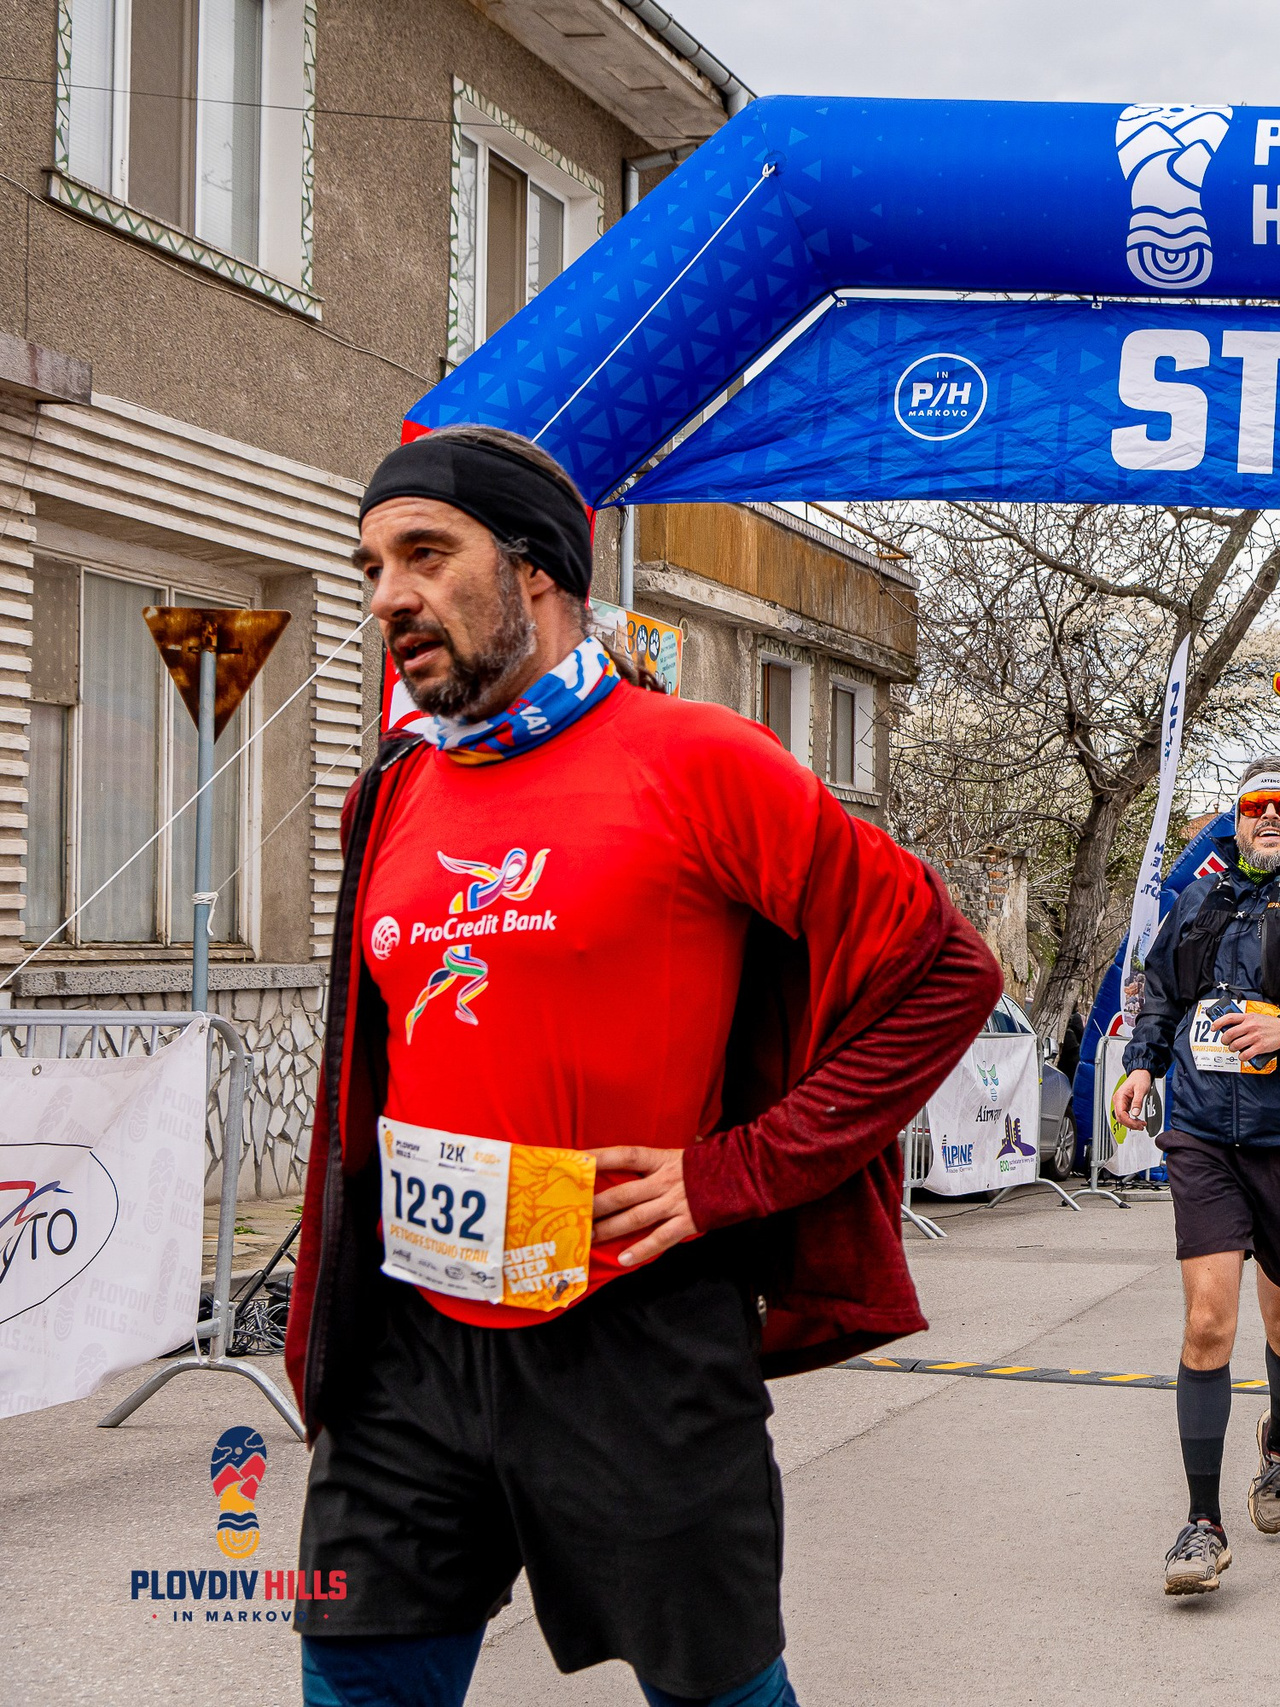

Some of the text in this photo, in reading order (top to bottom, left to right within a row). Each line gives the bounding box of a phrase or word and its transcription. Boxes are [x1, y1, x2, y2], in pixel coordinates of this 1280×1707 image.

[936, 371, 949, 379] IN
[911, 382, 972, 408] P/H
[908, 409, 968, 417] MARKOVO
[410, 910, 558, 944] ProCredit Bank
[440, 1142, 465, 1163] 12K
[390, 1169, 486, 1242] 1232
[503, 1259, 548, 1281] STEP
